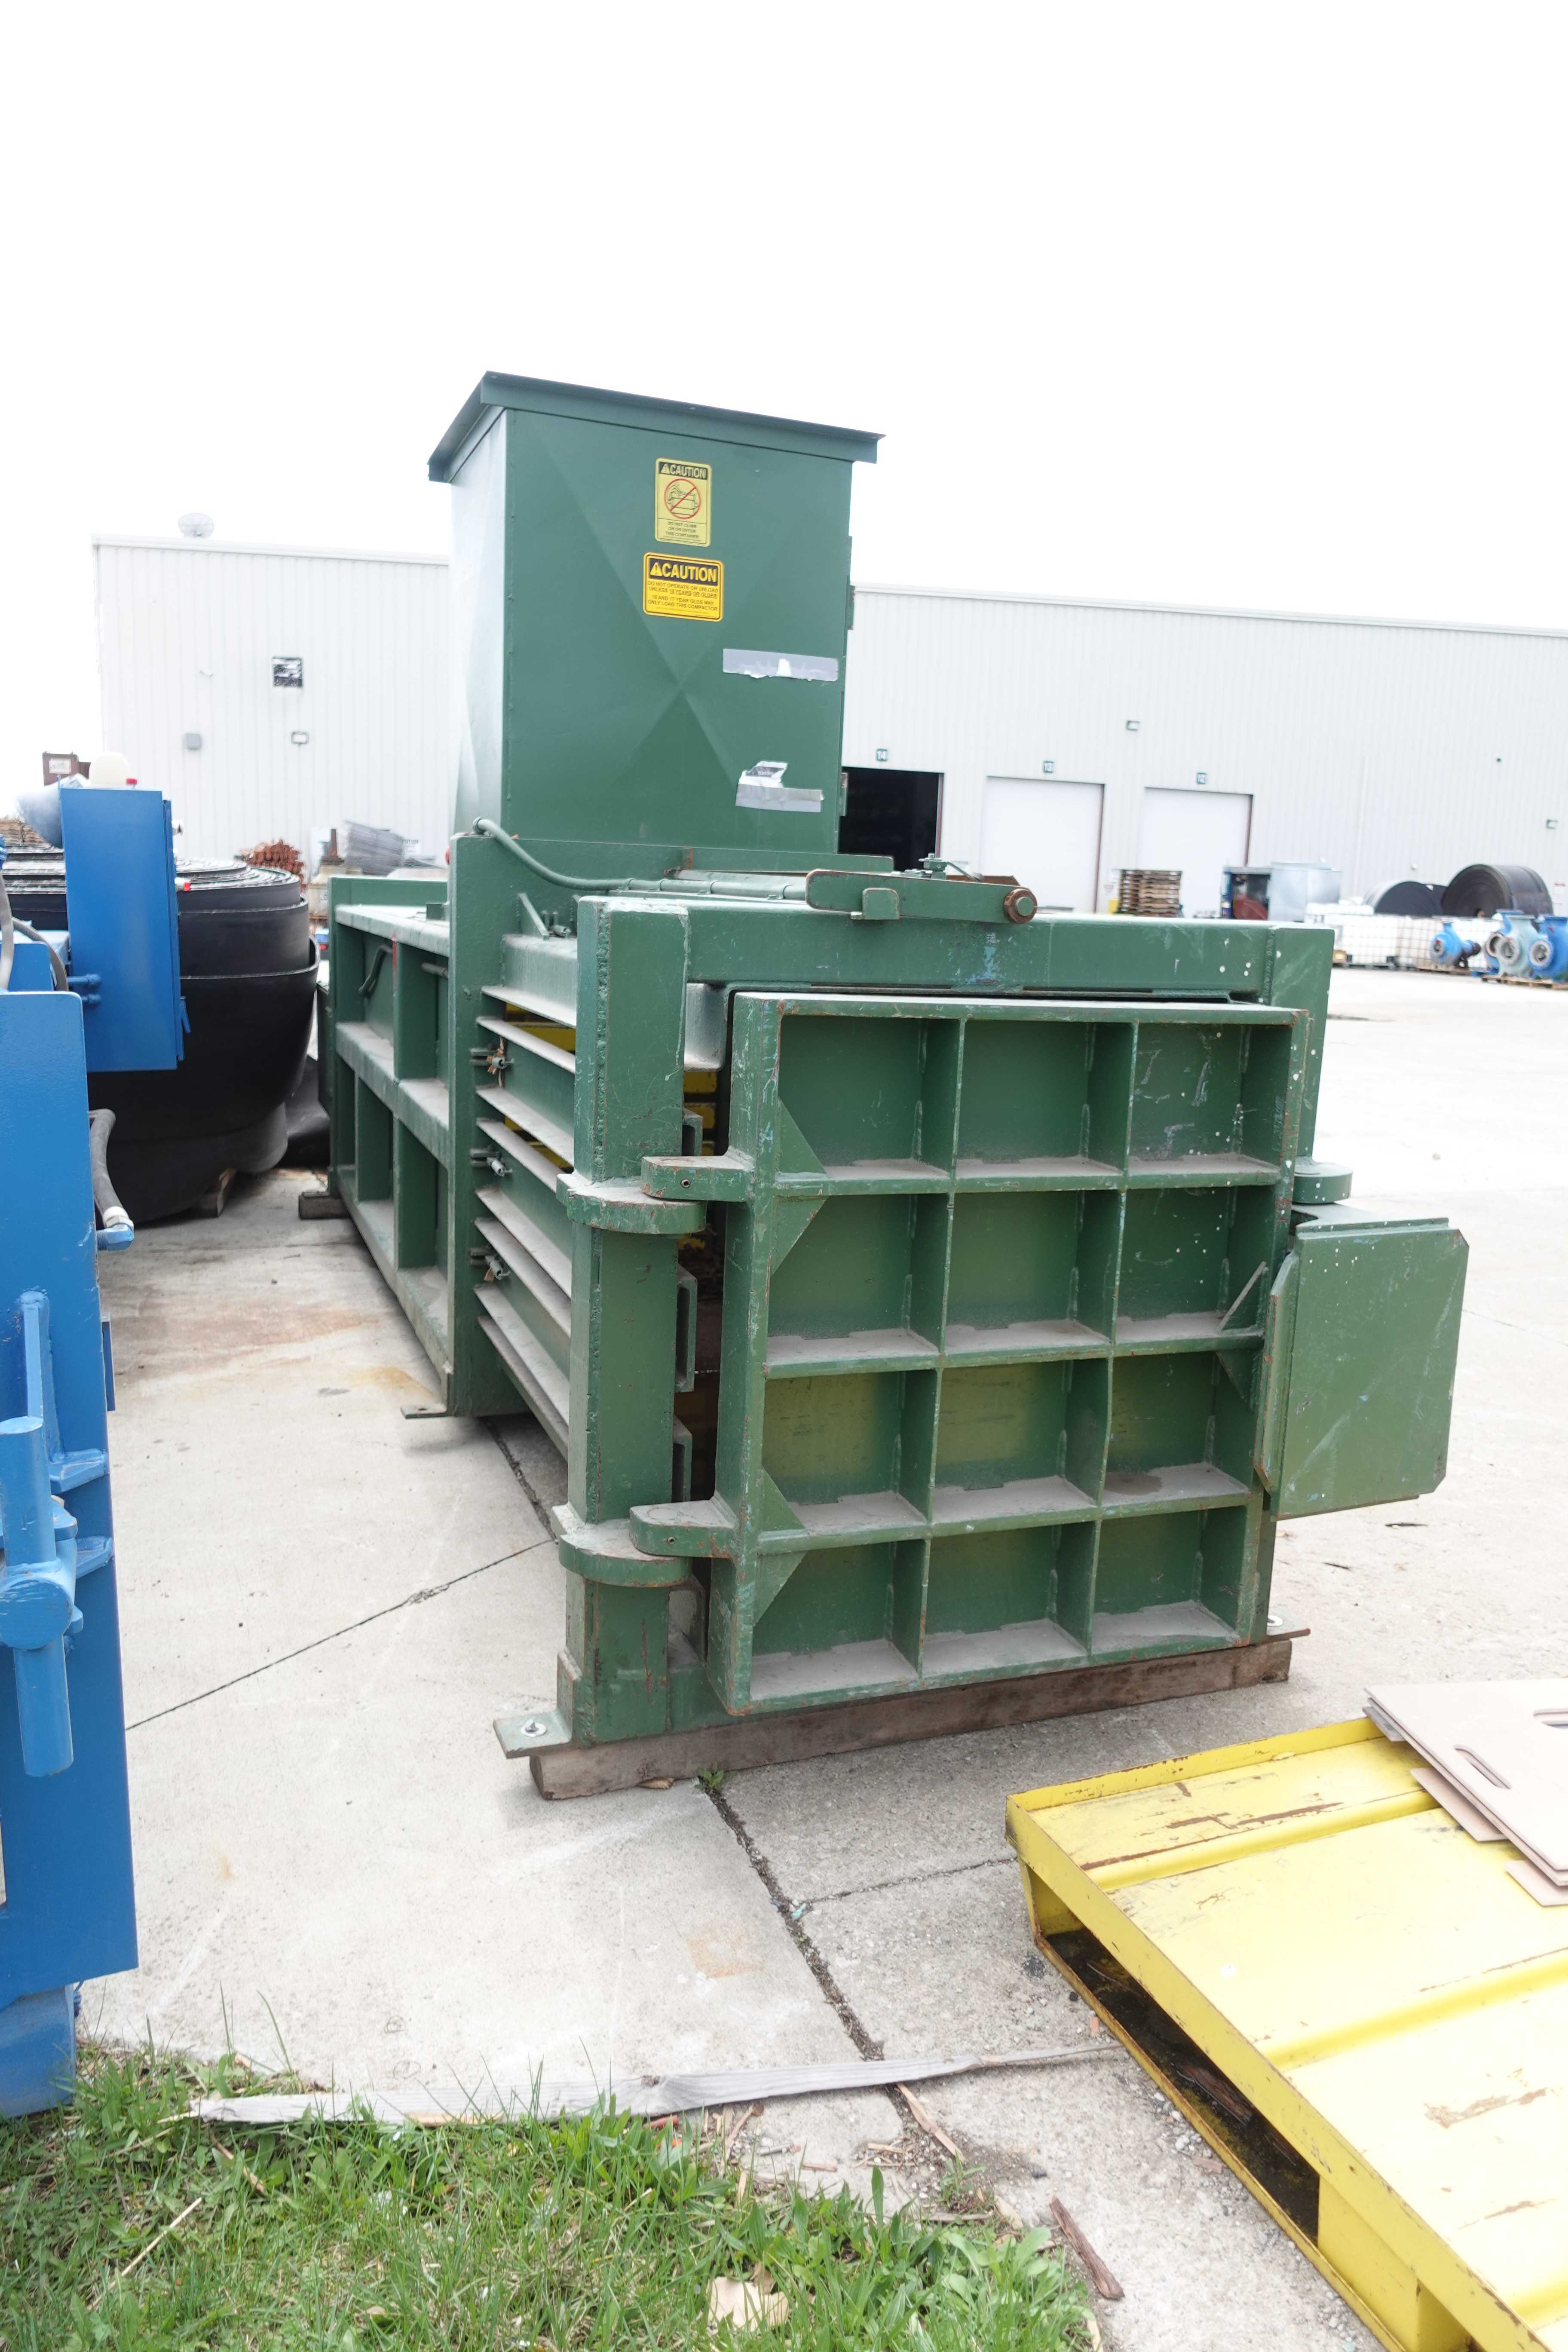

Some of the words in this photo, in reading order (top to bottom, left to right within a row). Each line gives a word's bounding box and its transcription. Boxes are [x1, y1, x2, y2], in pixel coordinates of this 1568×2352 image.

[670, 465, 706, 479] CAUTION
[662, 563, 717, 582] CAUTION
[877, 751, 886, 760] 14
